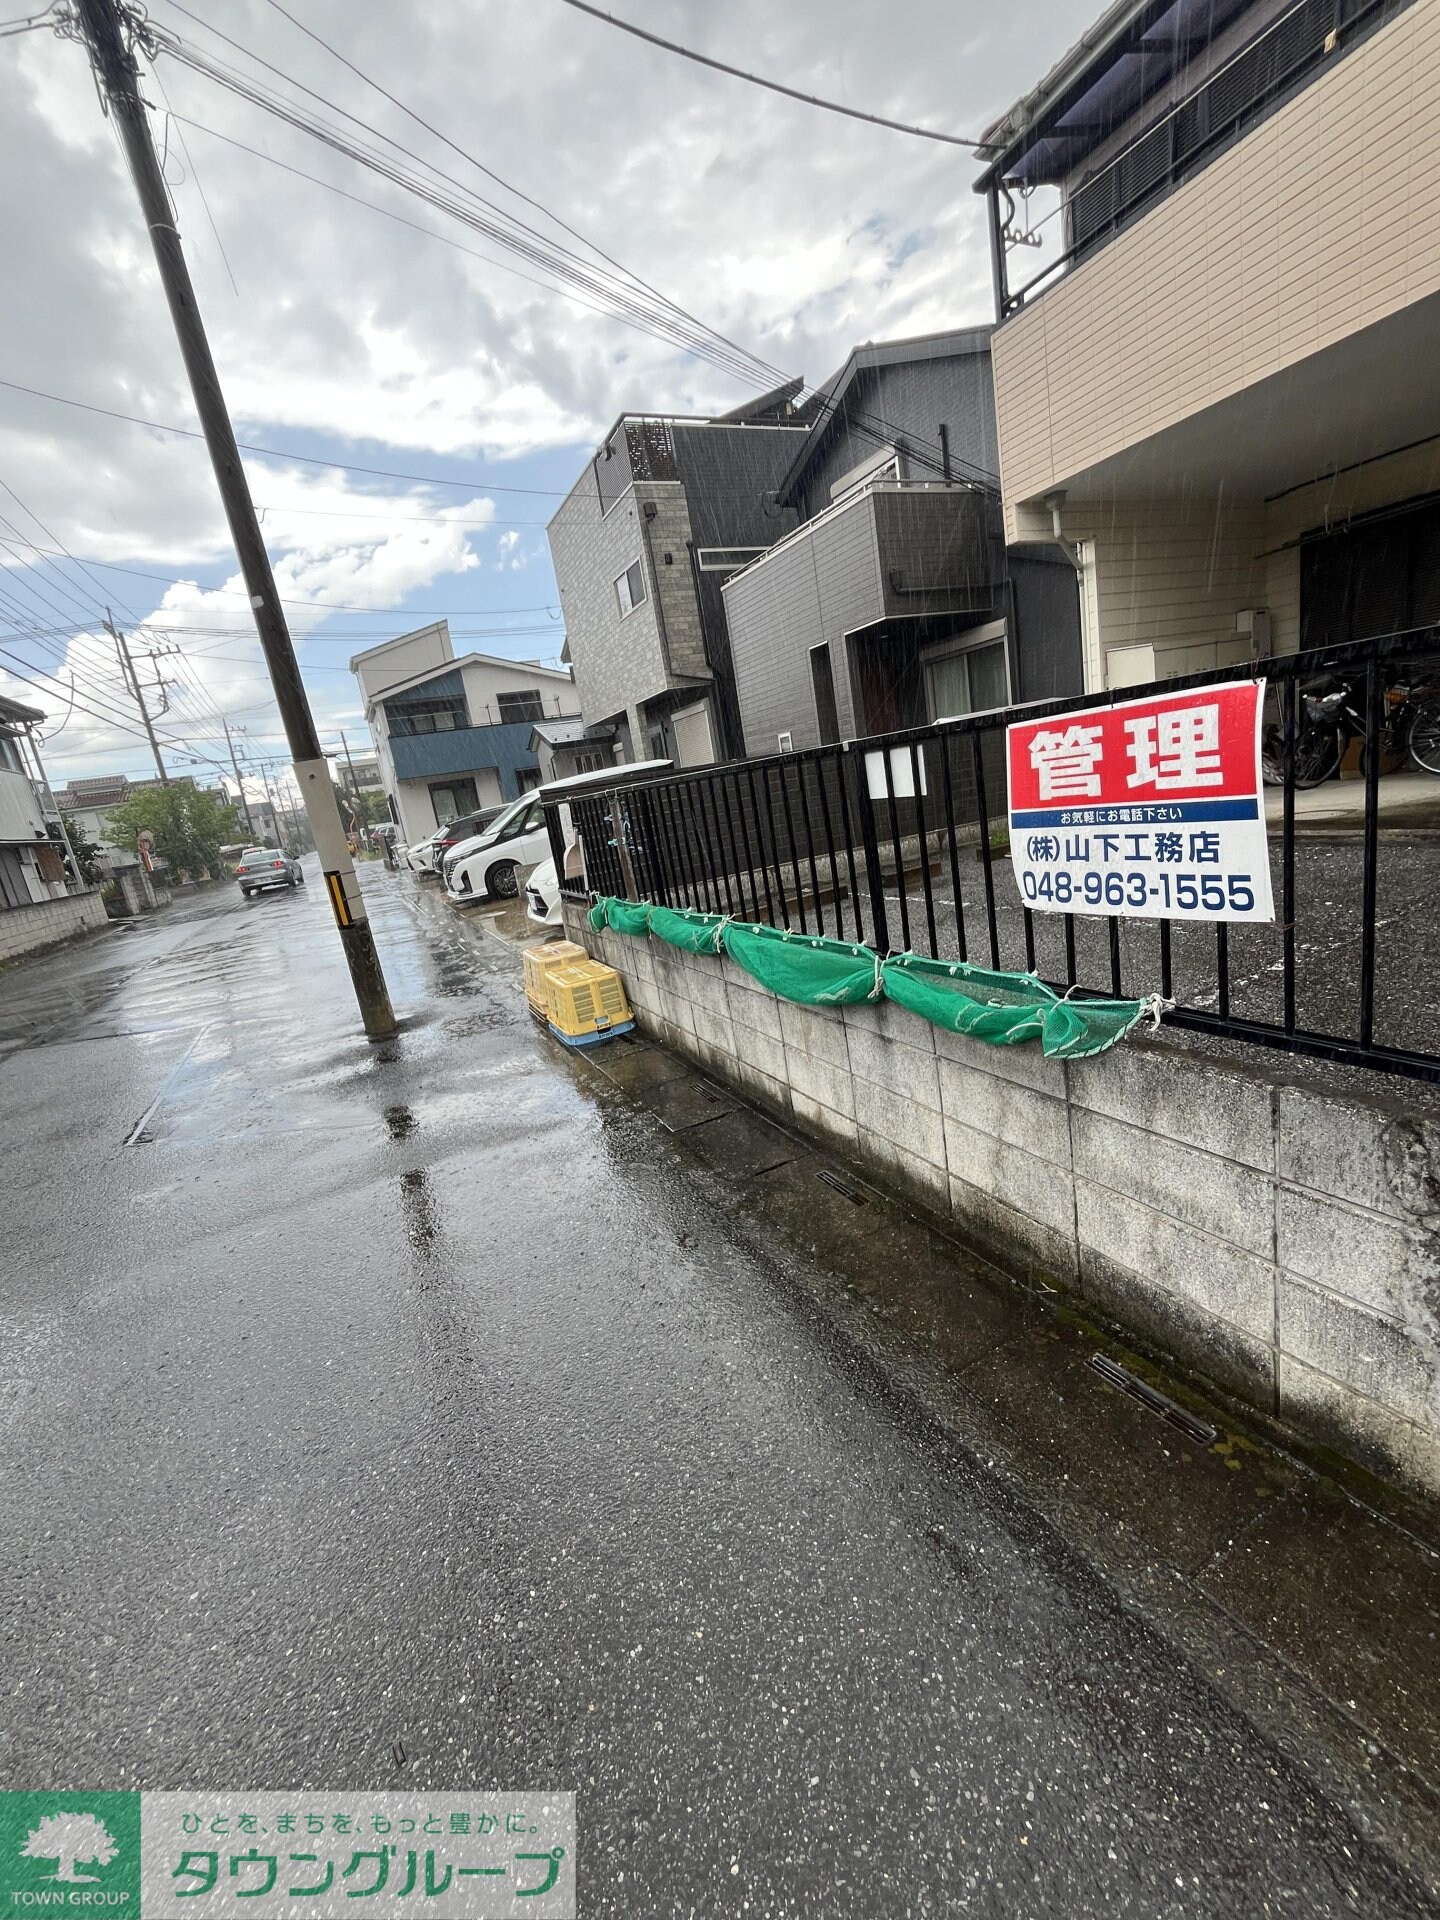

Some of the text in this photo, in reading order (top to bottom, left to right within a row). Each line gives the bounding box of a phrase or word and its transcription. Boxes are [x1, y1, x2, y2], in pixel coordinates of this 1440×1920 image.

[1028, 704, 1223, 800] 管理
[1060, 806, 1182, 824] お気軽にお電話下さい
[1027, 831, 1220, 864] (株)山下工務店
[1023, 871, 1255, 911] 048-963-1555
